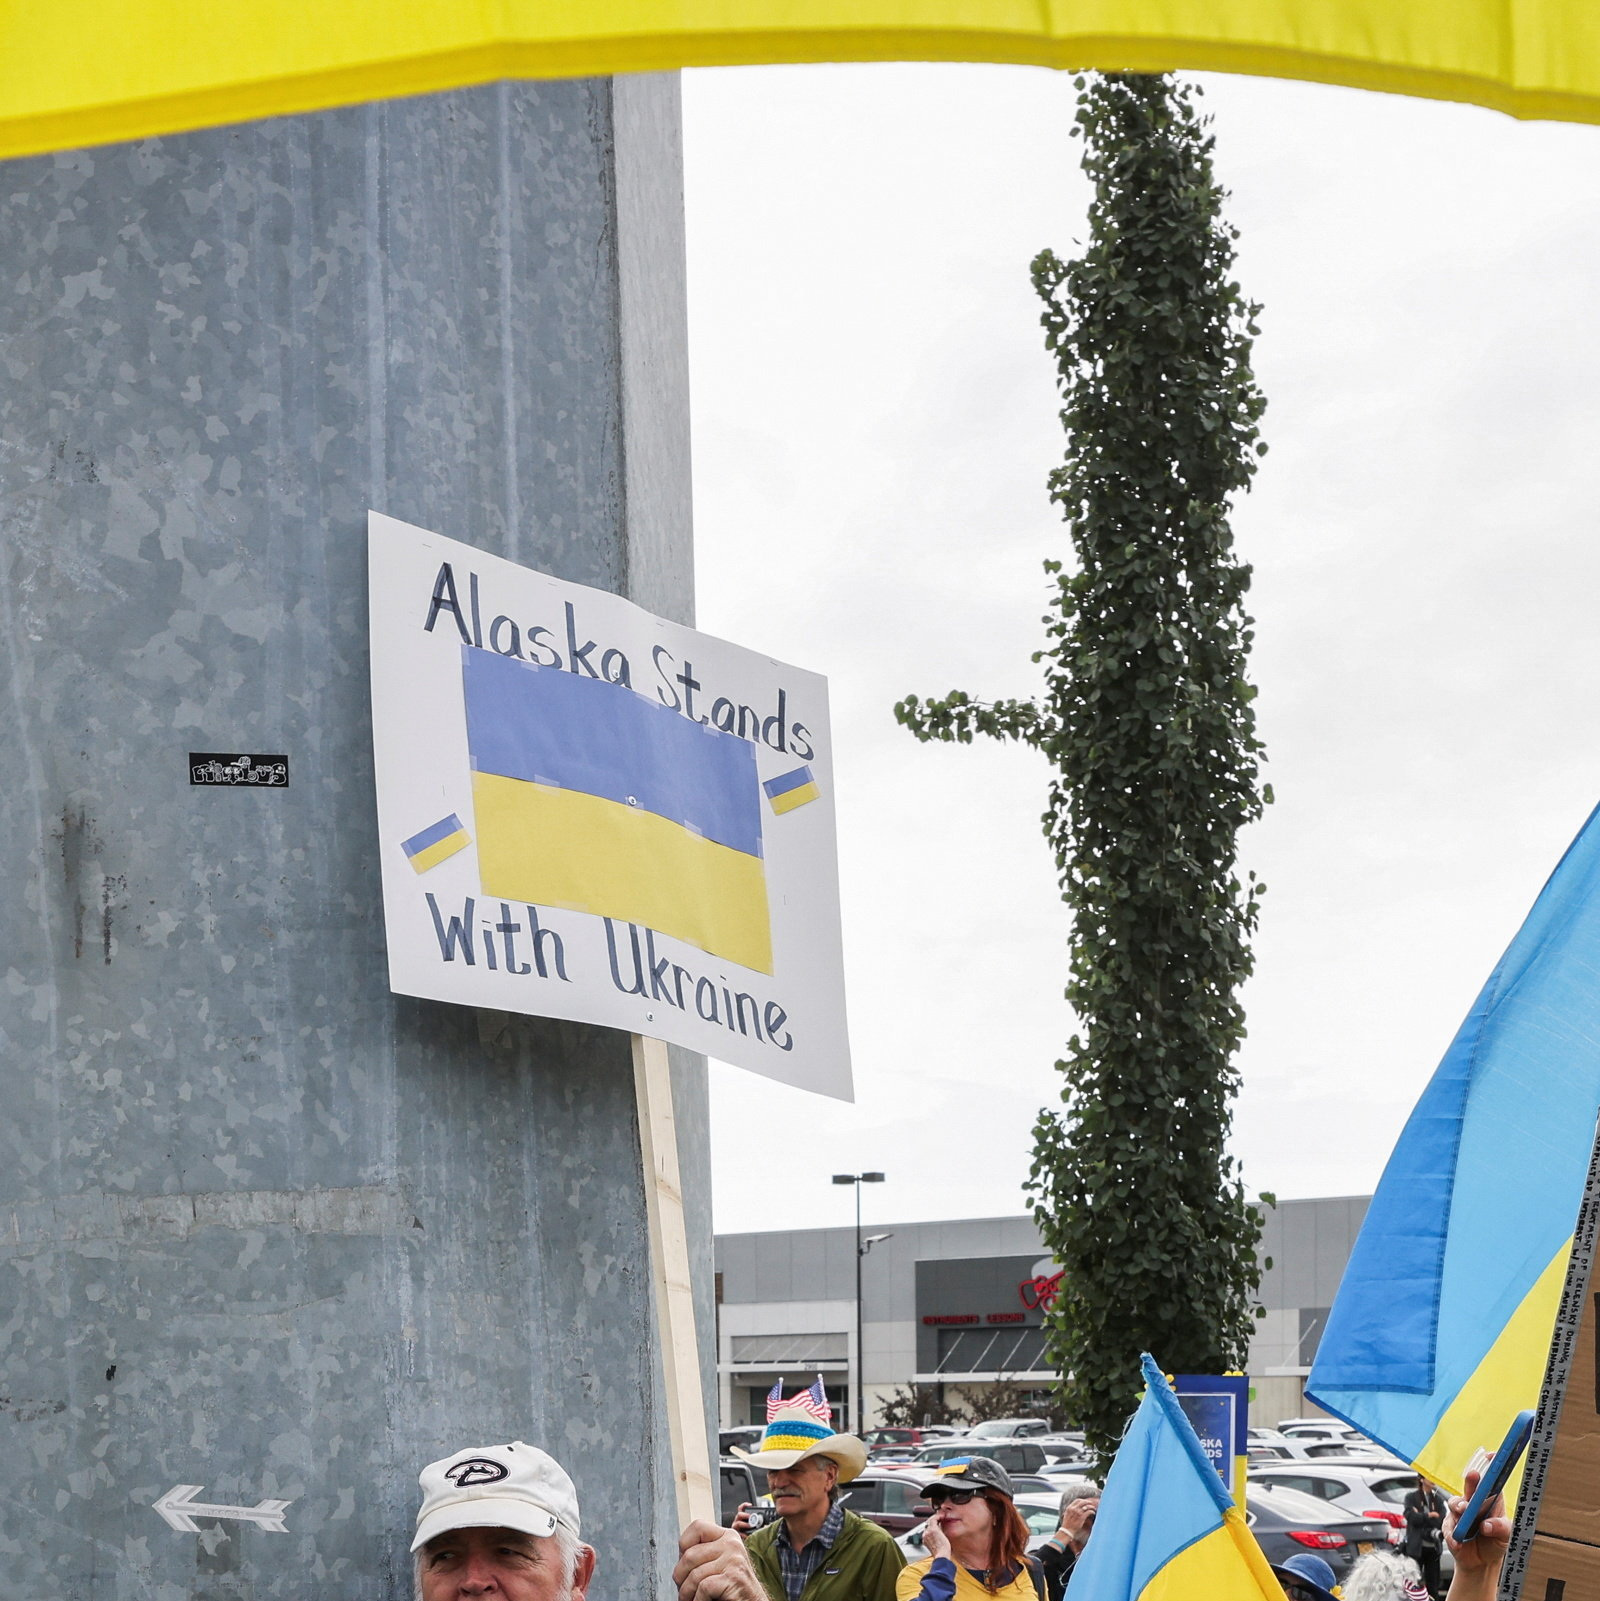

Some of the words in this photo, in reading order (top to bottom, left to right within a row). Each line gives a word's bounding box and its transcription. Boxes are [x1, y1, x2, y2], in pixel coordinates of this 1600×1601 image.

[423, 561, 632, 689] Alaska
[652, 645, 814, 760] Stands
[425, 892, 573, 983] With
[602, 917, 793, 1052] Ukraine
[1200, 1438, 1223, 1448] SKA
